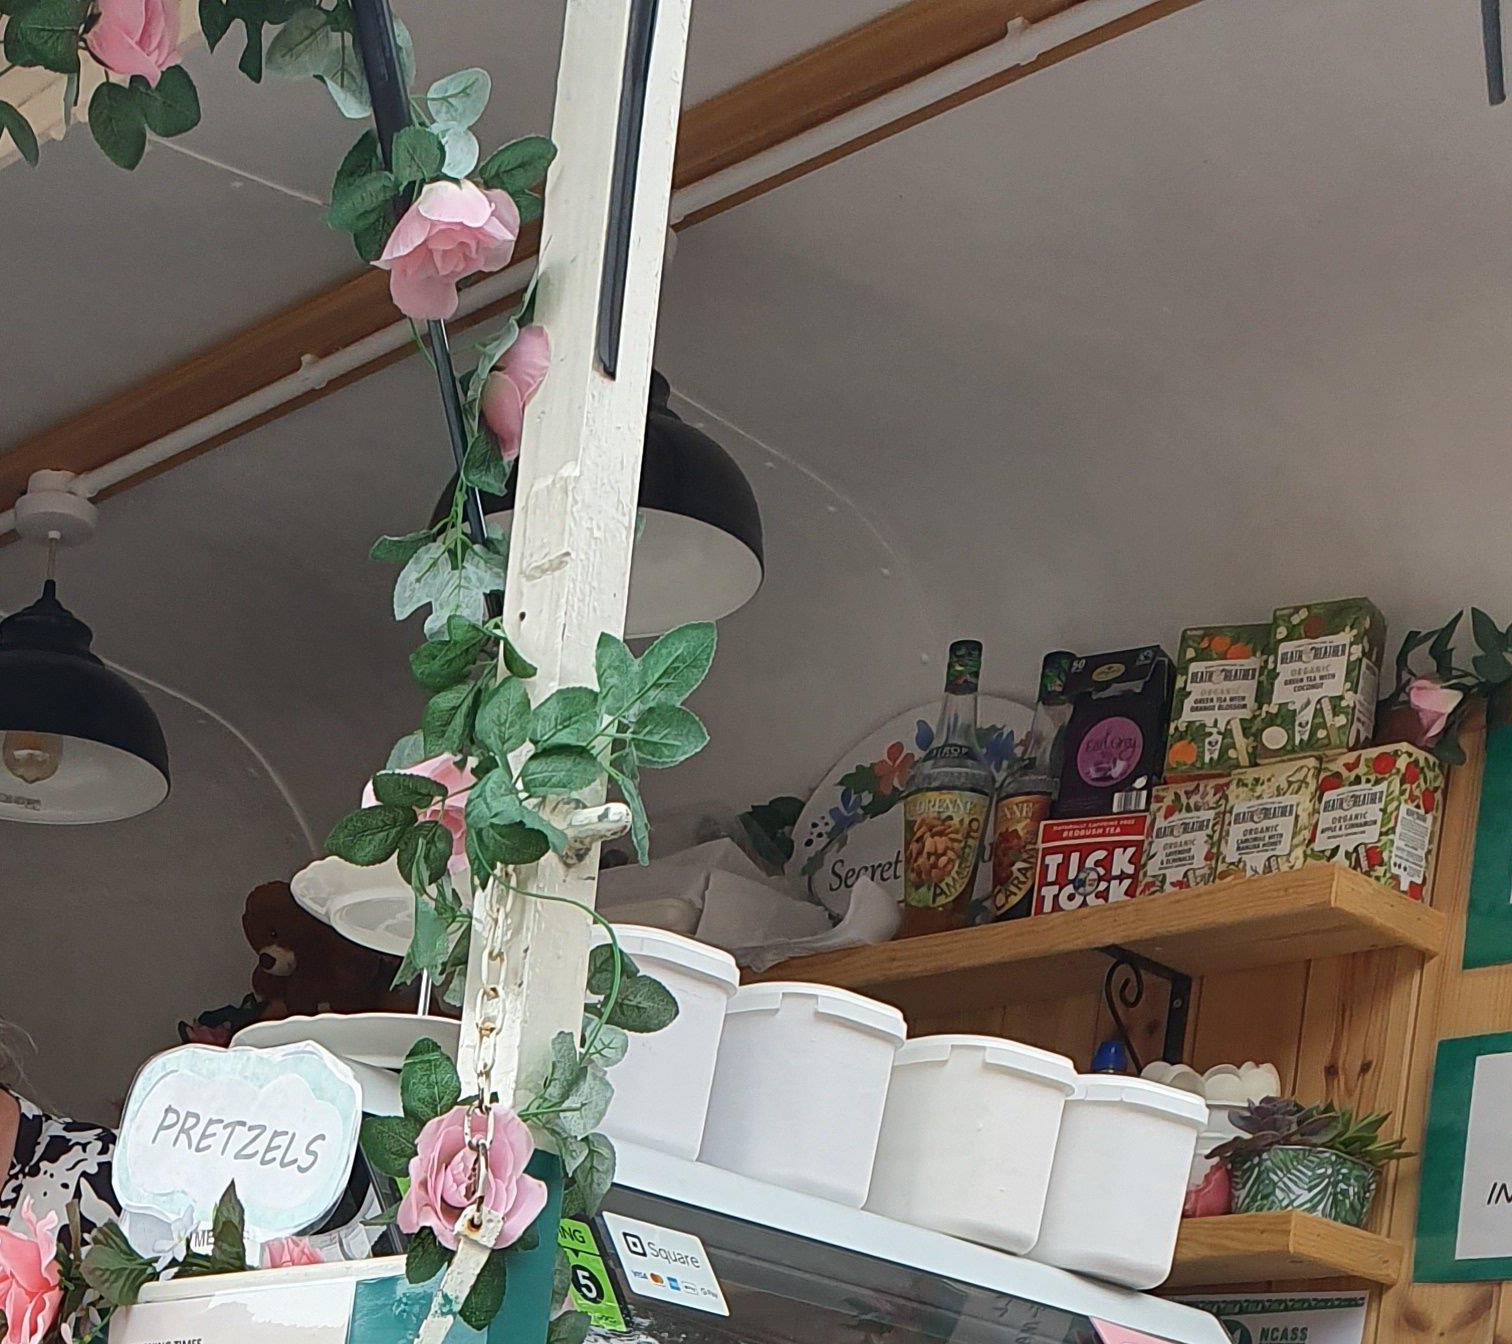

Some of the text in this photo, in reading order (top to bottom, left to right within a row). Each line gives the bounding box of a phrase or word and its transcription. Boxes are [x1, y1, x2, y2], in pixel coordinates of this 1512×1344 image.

[829, 851, 903, 893] Secret
[1044, 847, 1137, 882] TICK
[1040, 878, 1133, 913] TOCK
[151, 1104, 326, 1174] PRETZELS
[647, 1241, 701, 1269] Square
[576, 1268, 597, 1300] 5
[1259, 1327, 1308, 1341] NCASS
